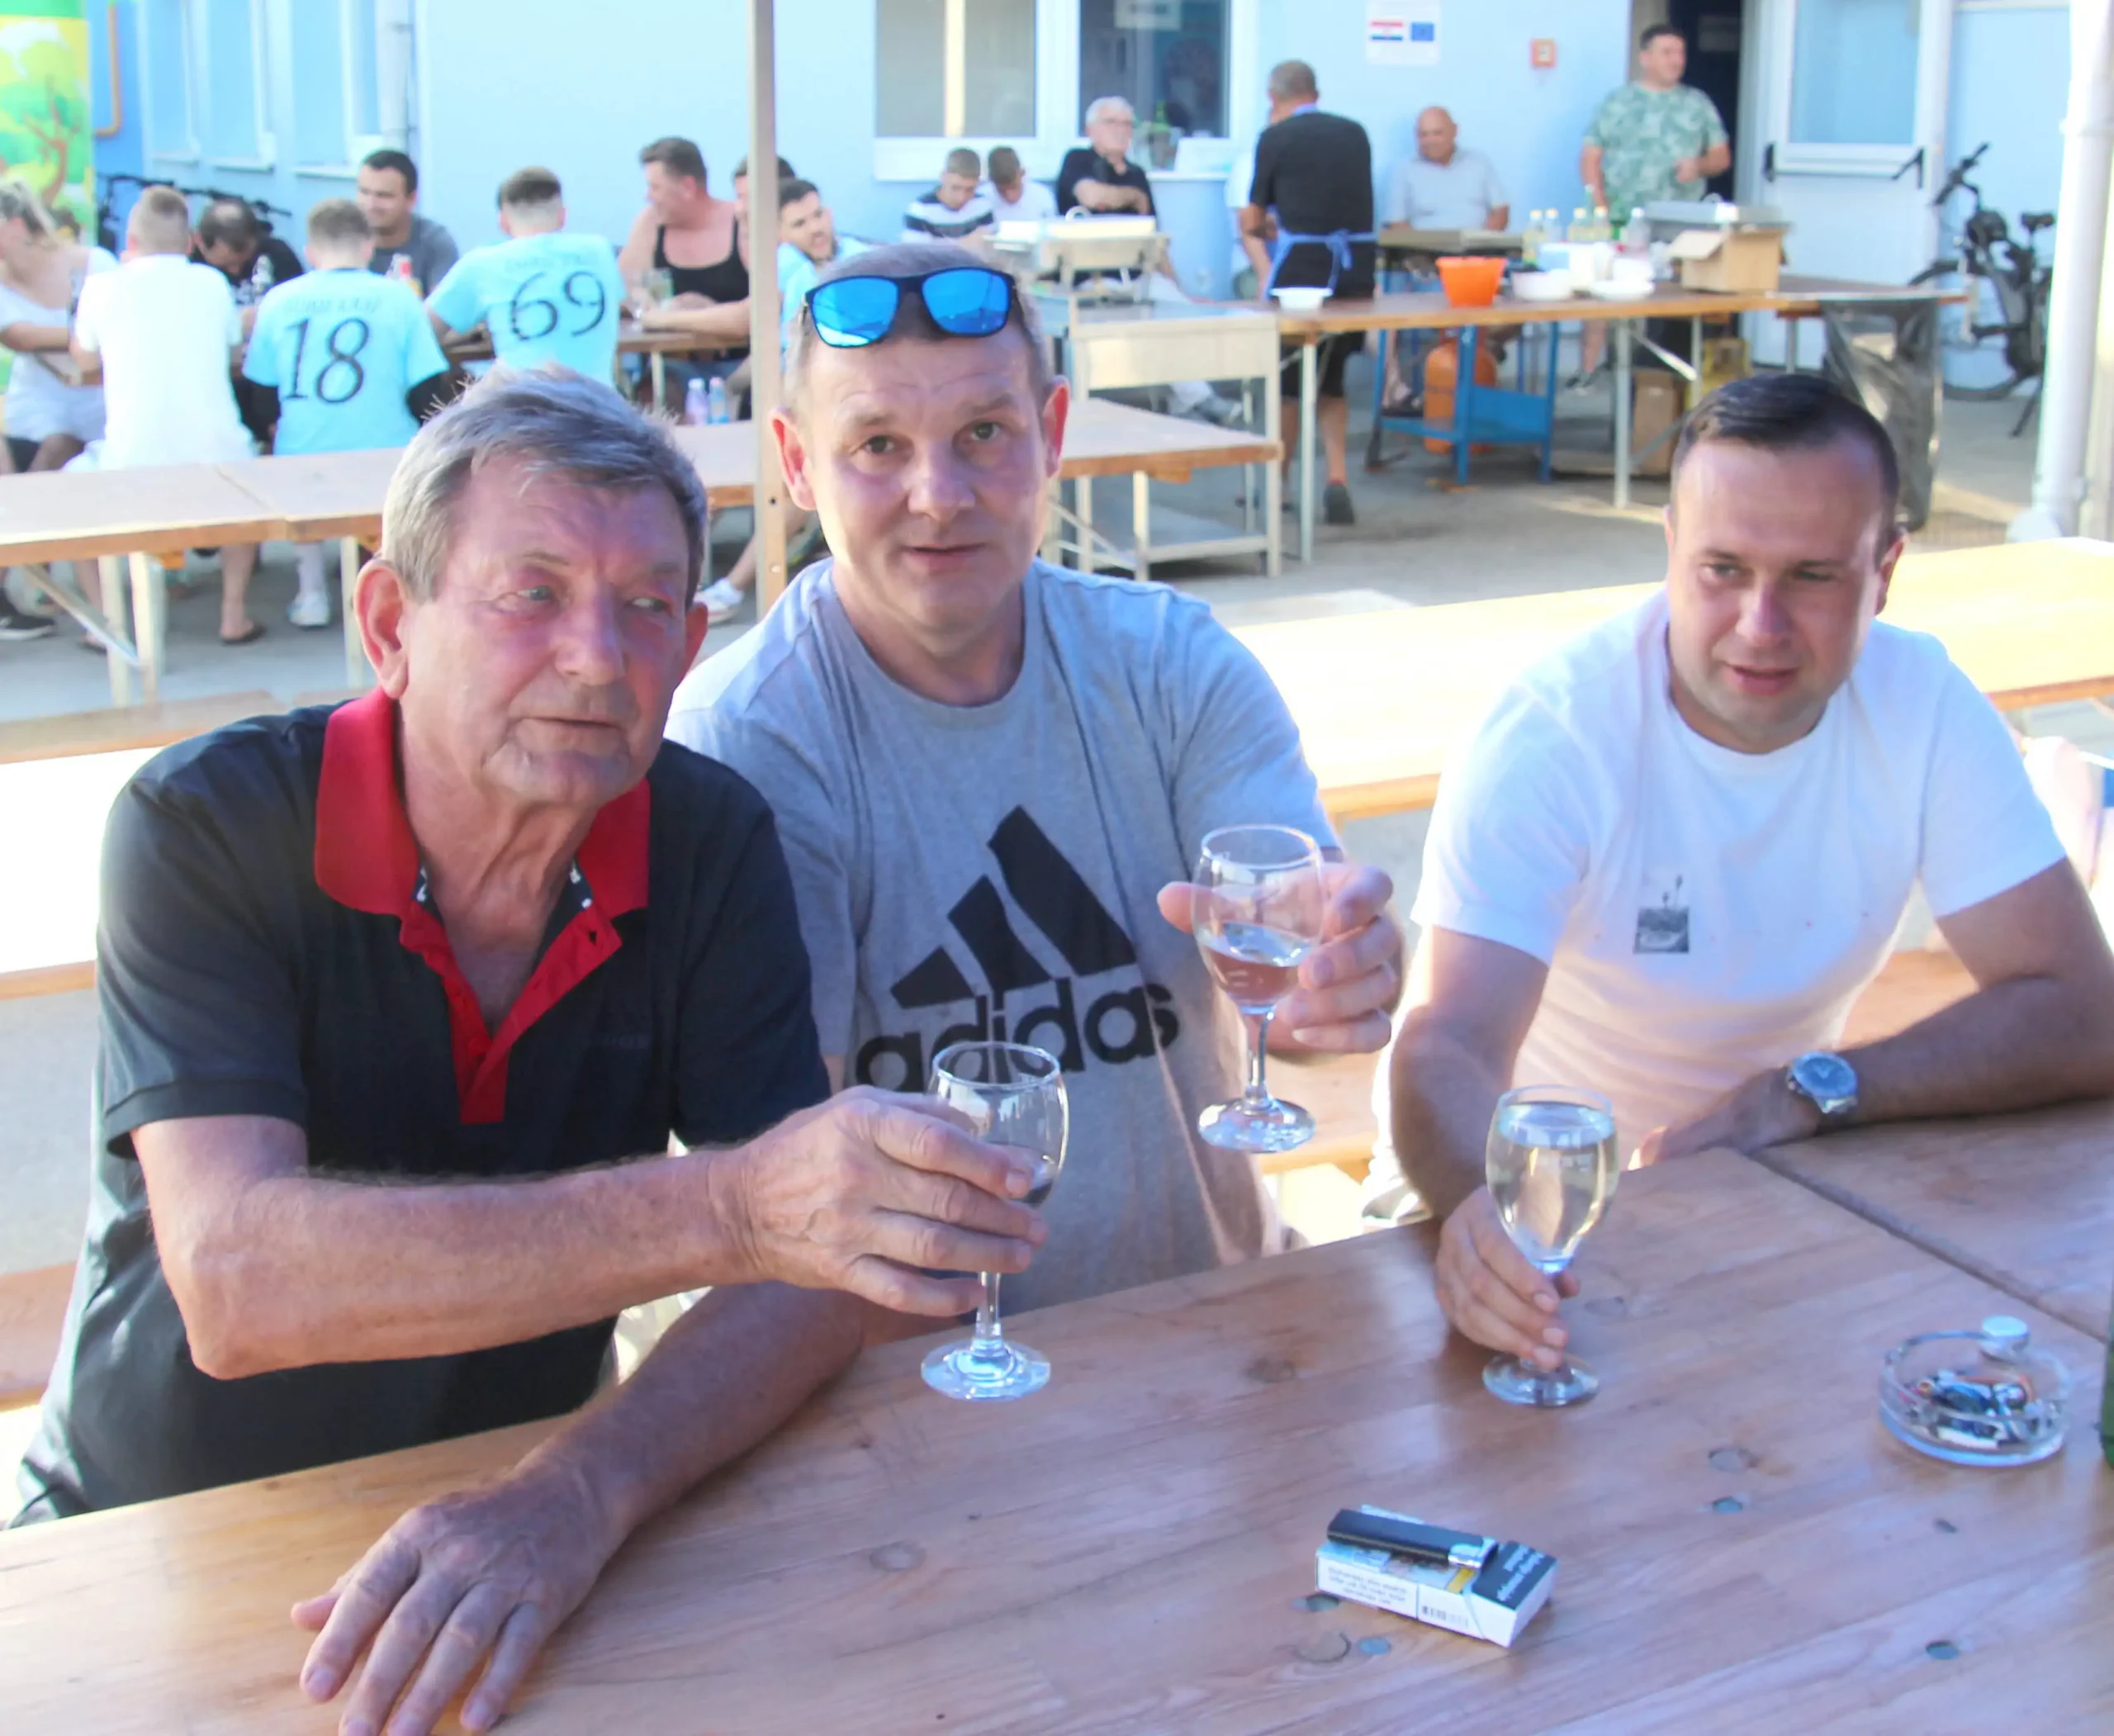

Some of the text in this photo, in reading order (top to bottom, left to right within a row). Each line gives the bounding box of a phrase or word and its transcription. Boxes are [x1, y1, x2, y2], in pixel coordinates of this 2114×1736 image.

[510, 271, 605, 340] 69
[284, 317, 371, 405] 18
[856, 977, 1179, 1092] adidas
